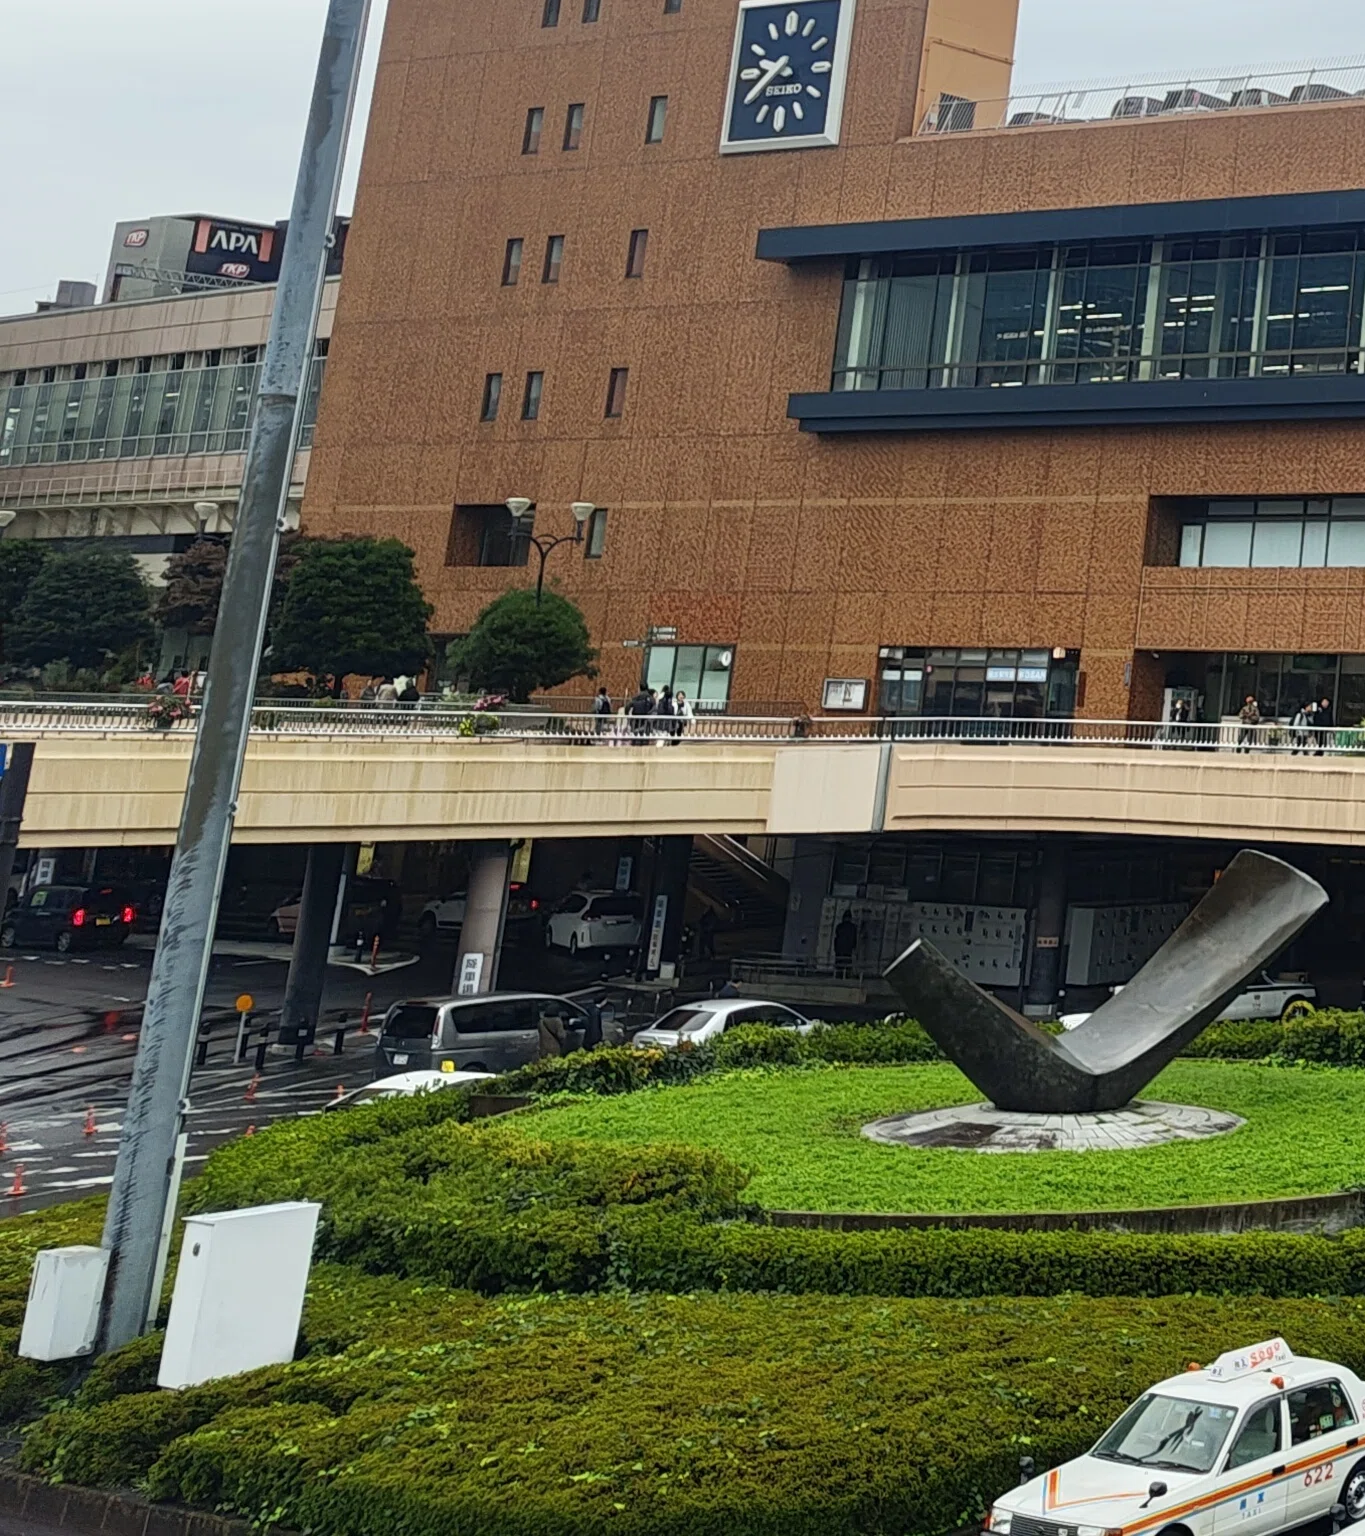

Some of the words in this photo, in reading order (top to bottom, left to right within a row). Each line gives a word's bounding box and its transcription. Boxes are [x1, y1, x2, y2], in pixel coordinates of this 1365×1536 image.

[765, 83, 802, 97] SEIKO
[126, 231, 147, 244] TKP
[210, 229, 258, 255] APA
[220, 264, 247, 276] TKP
[1304, 1462, 1334, 1488] 622
